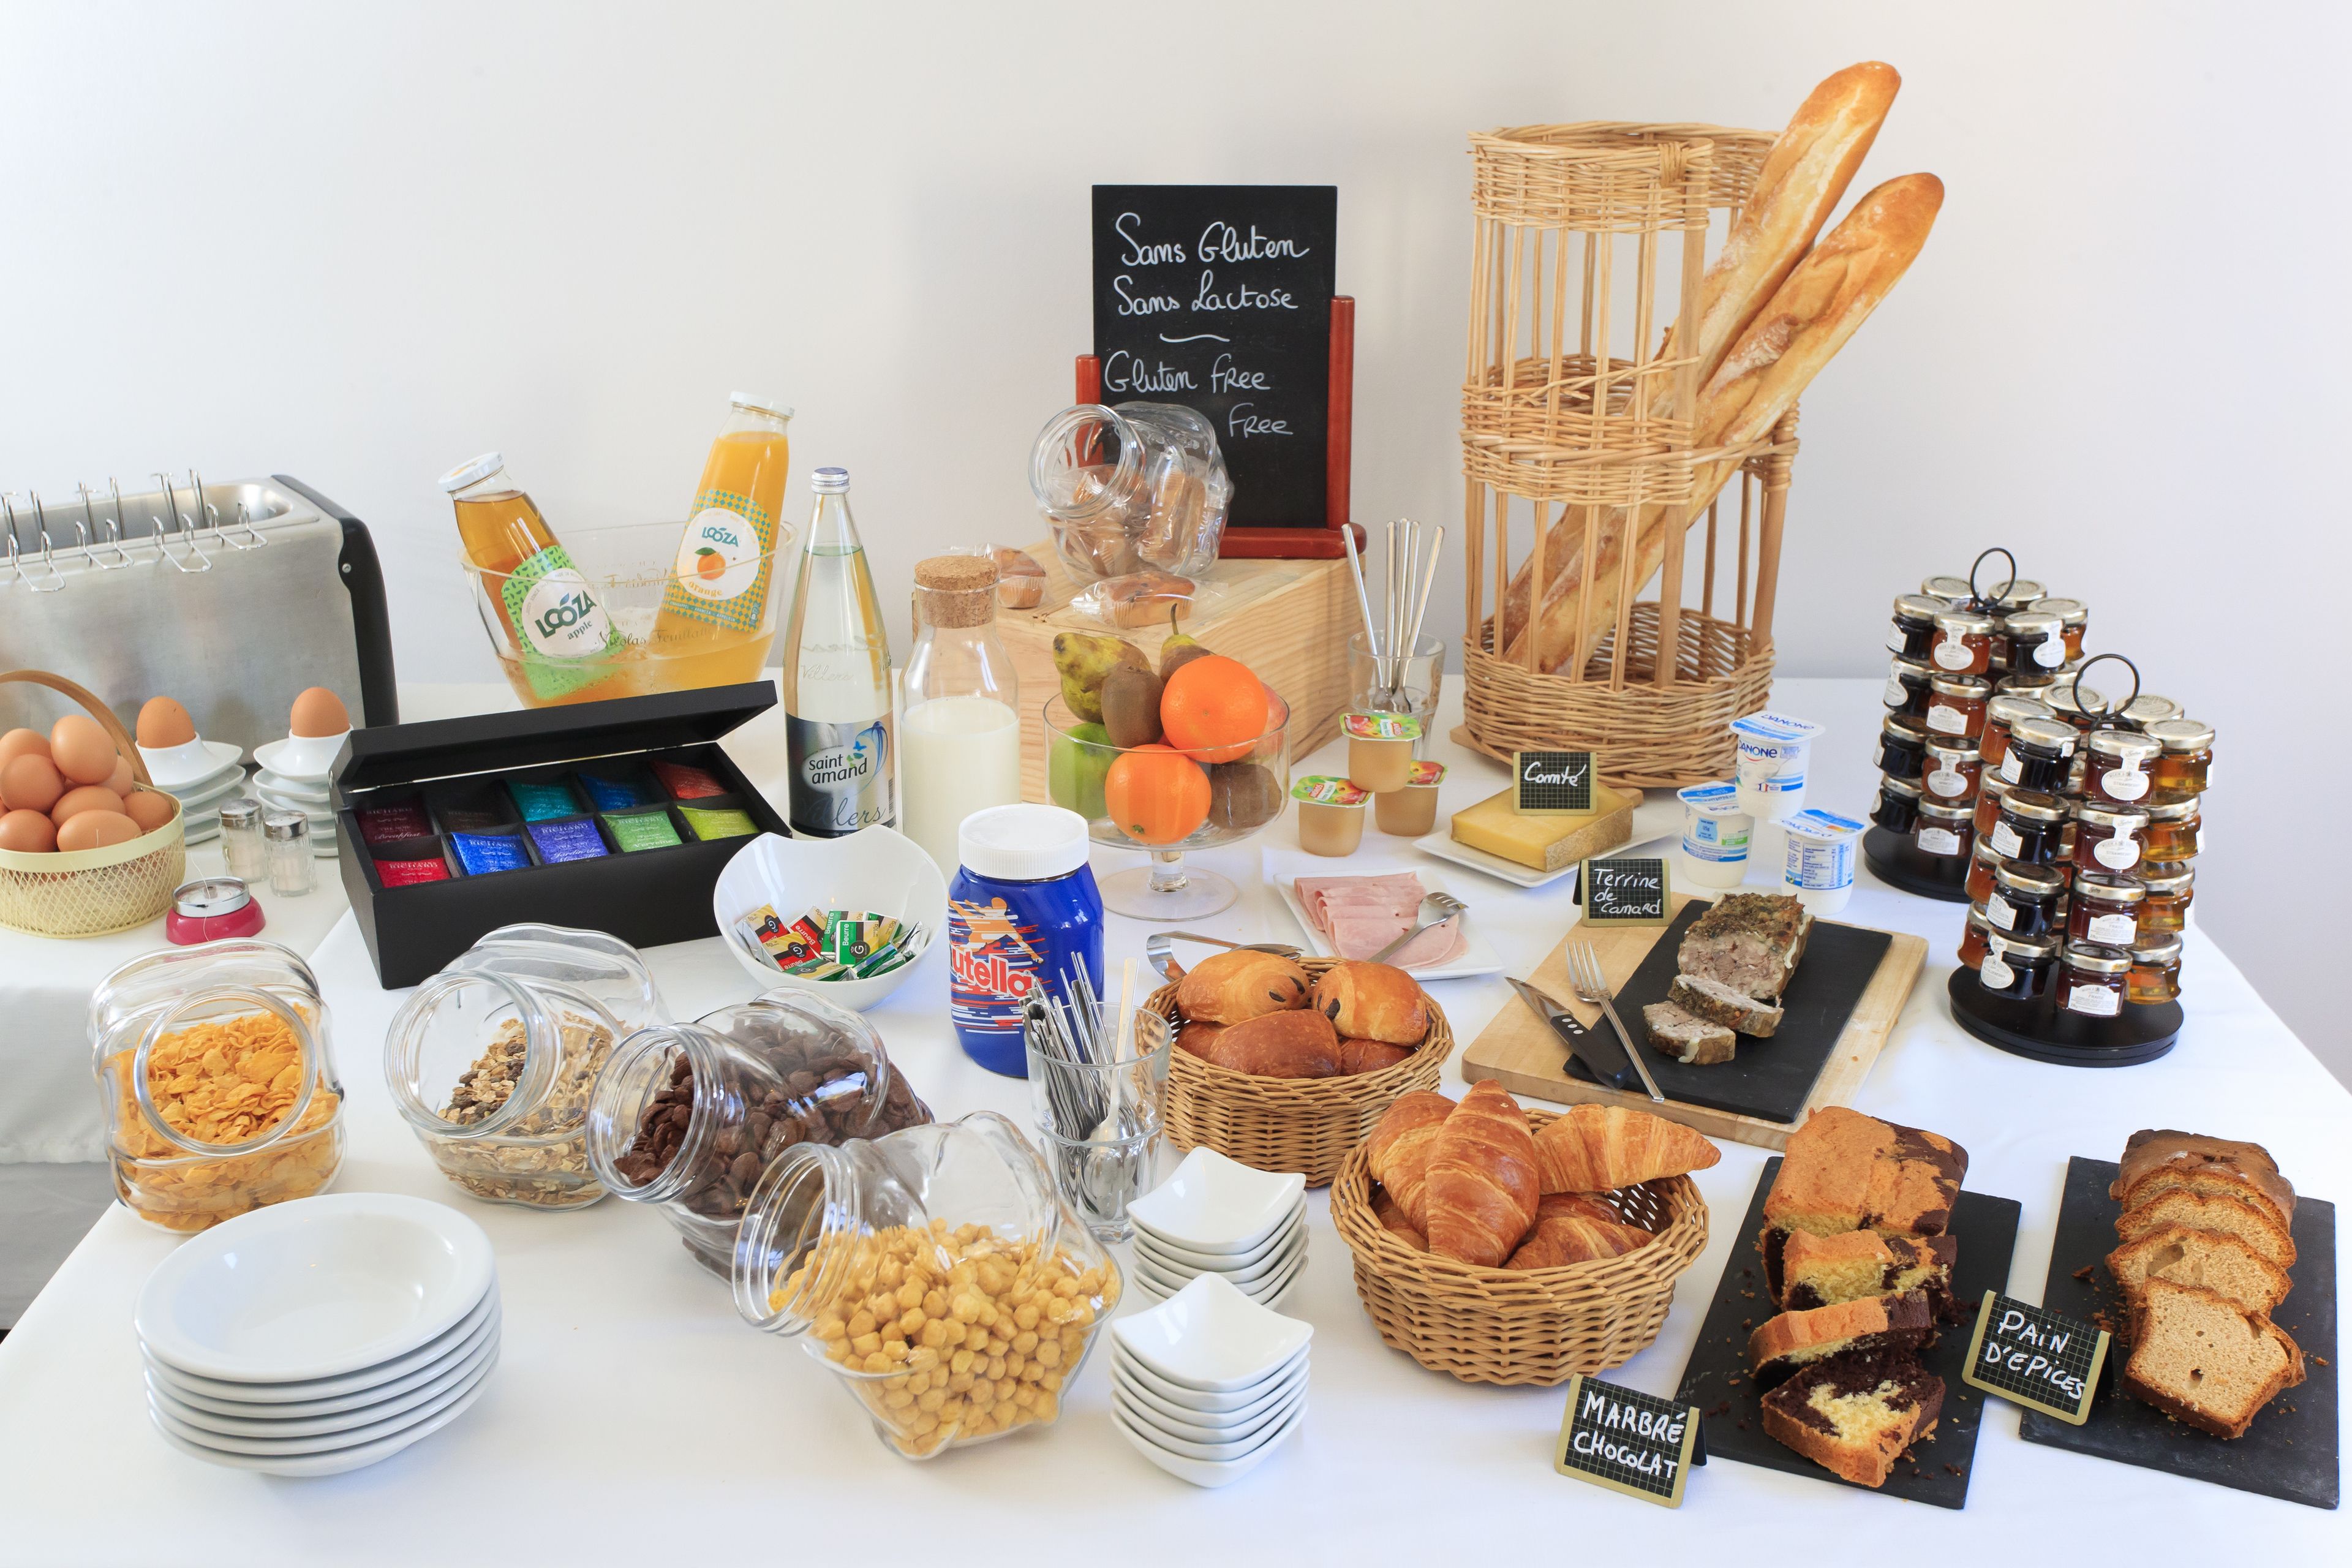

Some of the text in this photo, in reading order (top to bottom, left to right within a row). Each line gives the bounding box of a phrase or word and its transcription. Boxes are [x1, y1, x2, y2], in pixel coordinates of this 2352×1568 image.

[1116, 212, 1310, 266] Sans Gluten
[1114, 270, 1298, 315] Sans Lactose
[1104, 350, 1197, 393] Gluten
[688, 581, 723, 598] orange
[567, 619, 594, 641] apple
[808, 753, 844, 771] saint
[811, 757, 868, 785] amand
[1523, 761, 1587, 786] Comté
[1594, 868, 1661, 889] Terrine
[1594, 887, 1618, 902] de
[794, 925, 816, 946] Beurre
[824, 912, 835, 935] Beurre
[952, 947, 1035, 998] utella
[1583, 1390, 1686, 1443] MARBRÉ
[1574, 1430, 1678, 1479] CHOCOLAT
